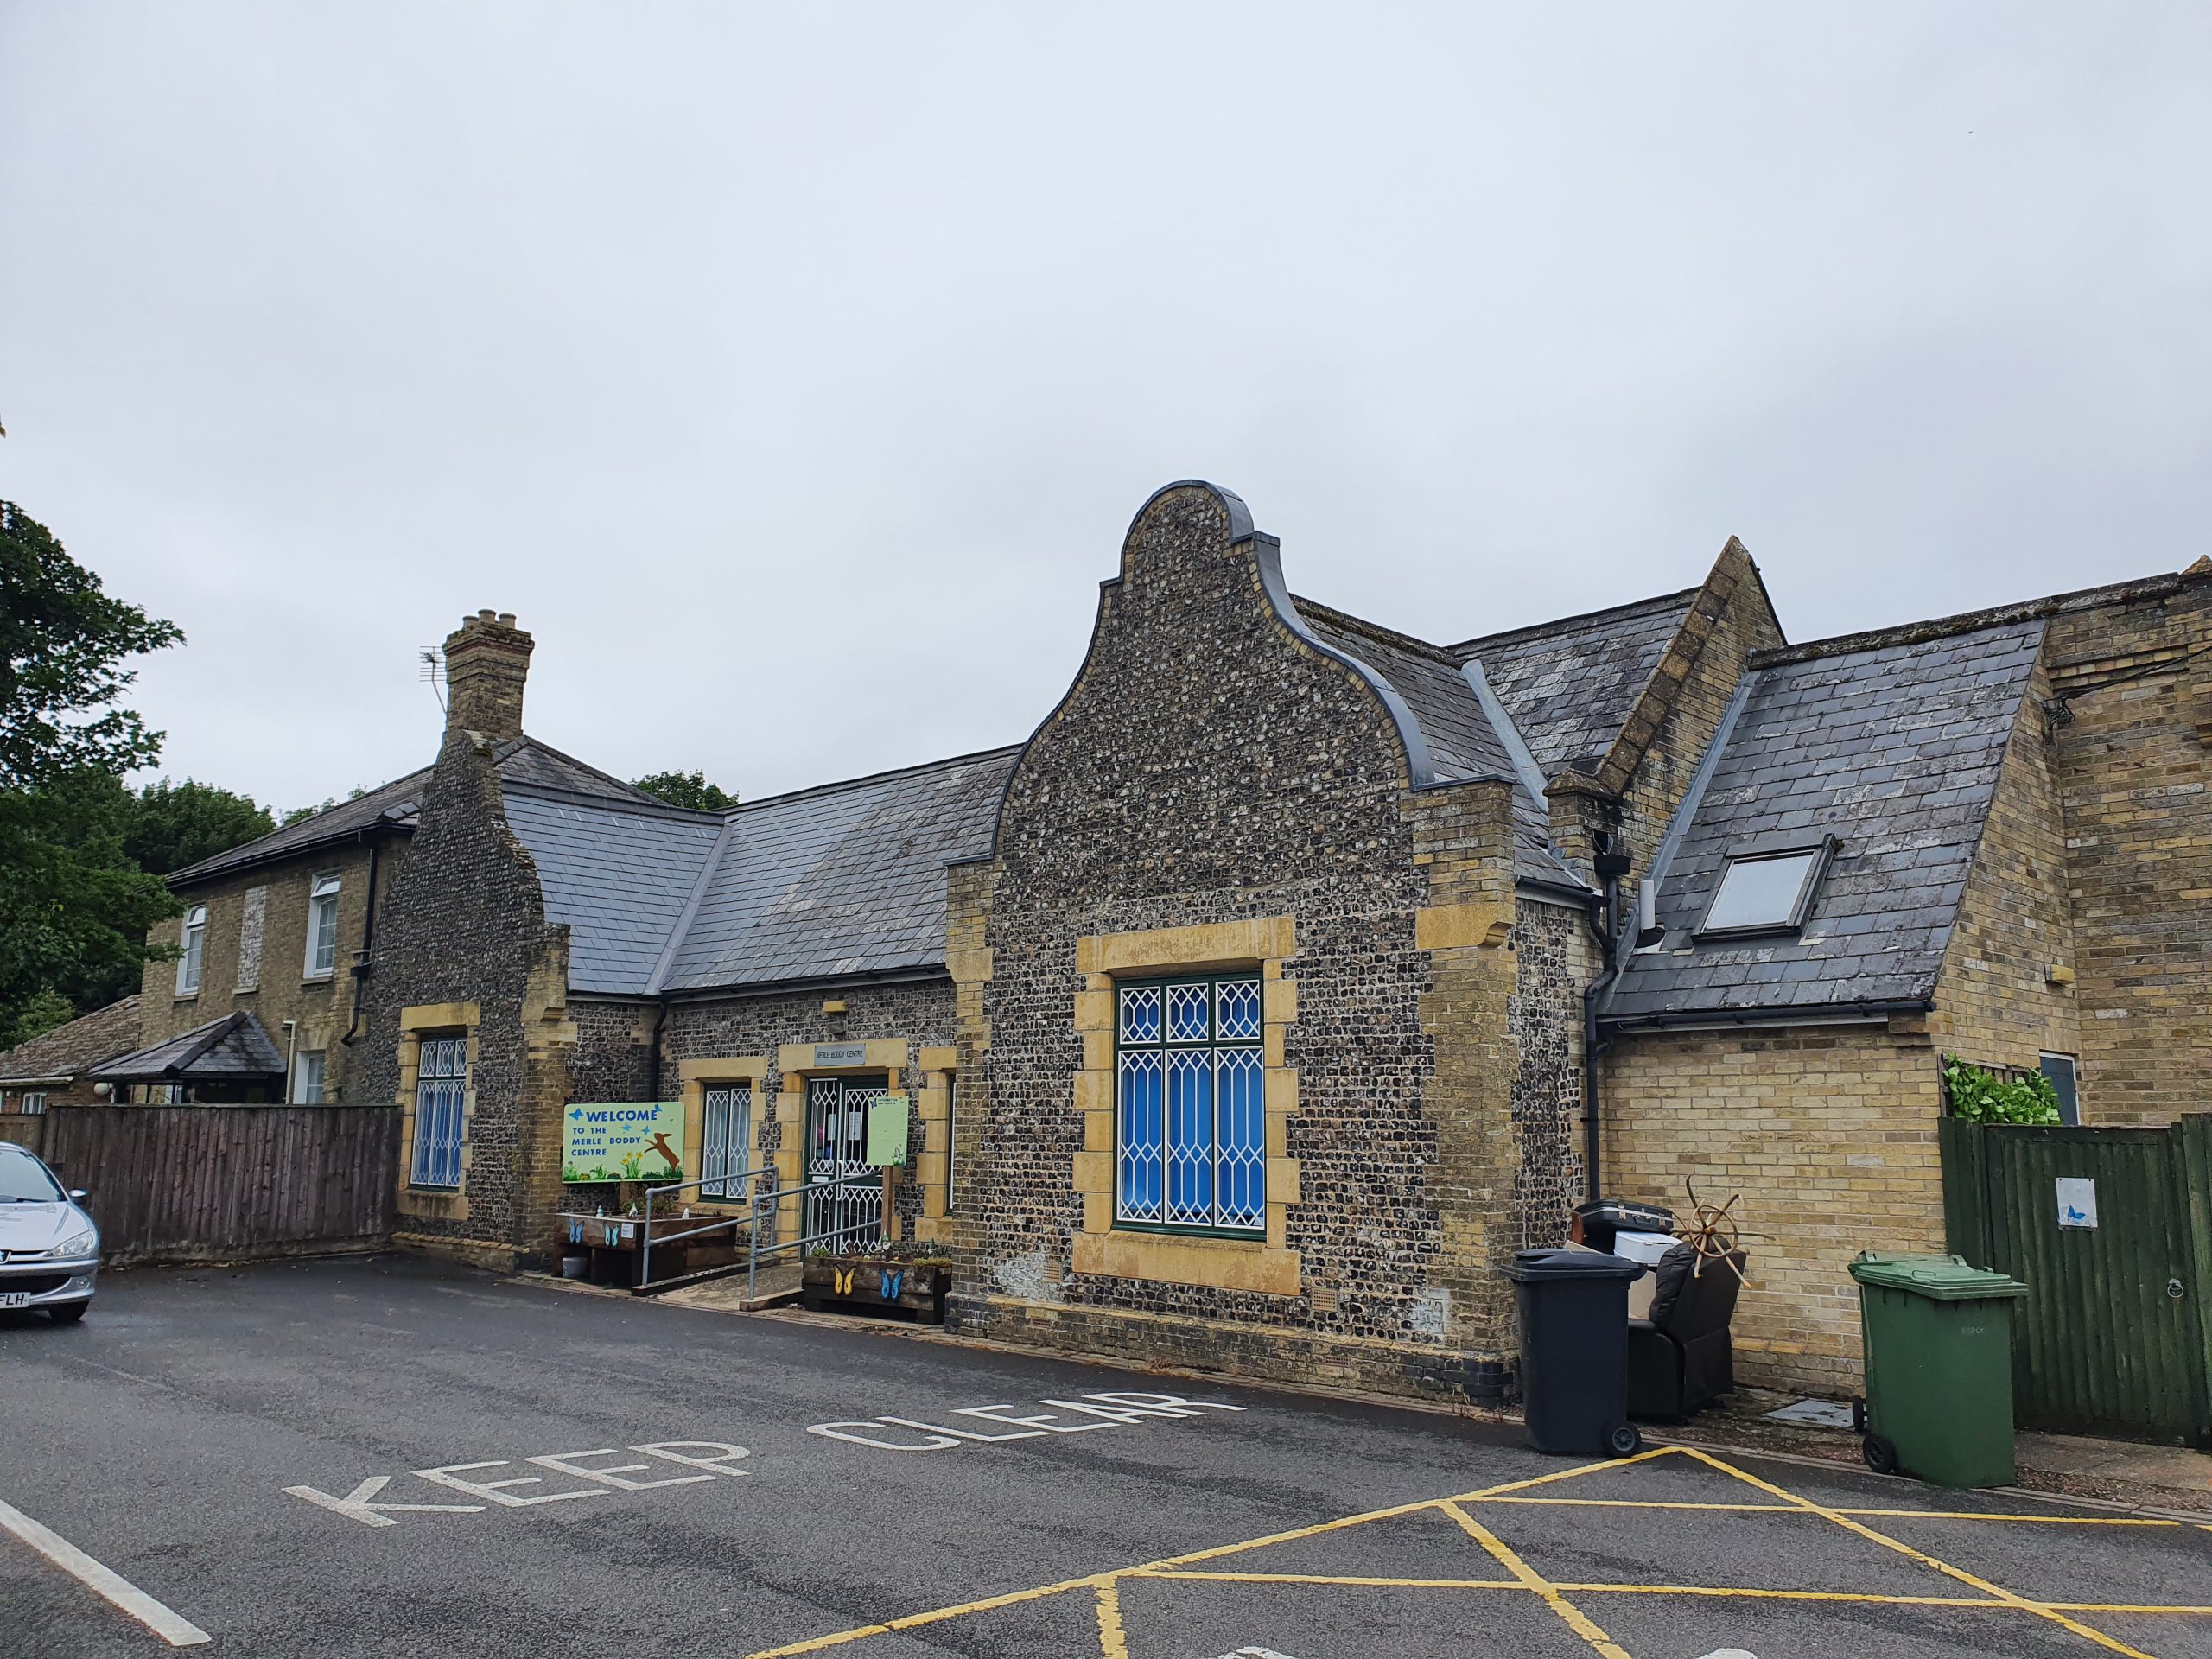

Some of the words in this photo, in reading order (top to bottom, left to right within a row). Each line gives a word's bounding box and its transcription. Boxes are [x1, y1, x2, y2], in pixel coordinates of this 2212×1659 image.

[587, 1110, 657, 1122] WELCOME
[282, 1440, 751, 1528] KEEP
[806, 1392, 1247, 1451] CLEAR
